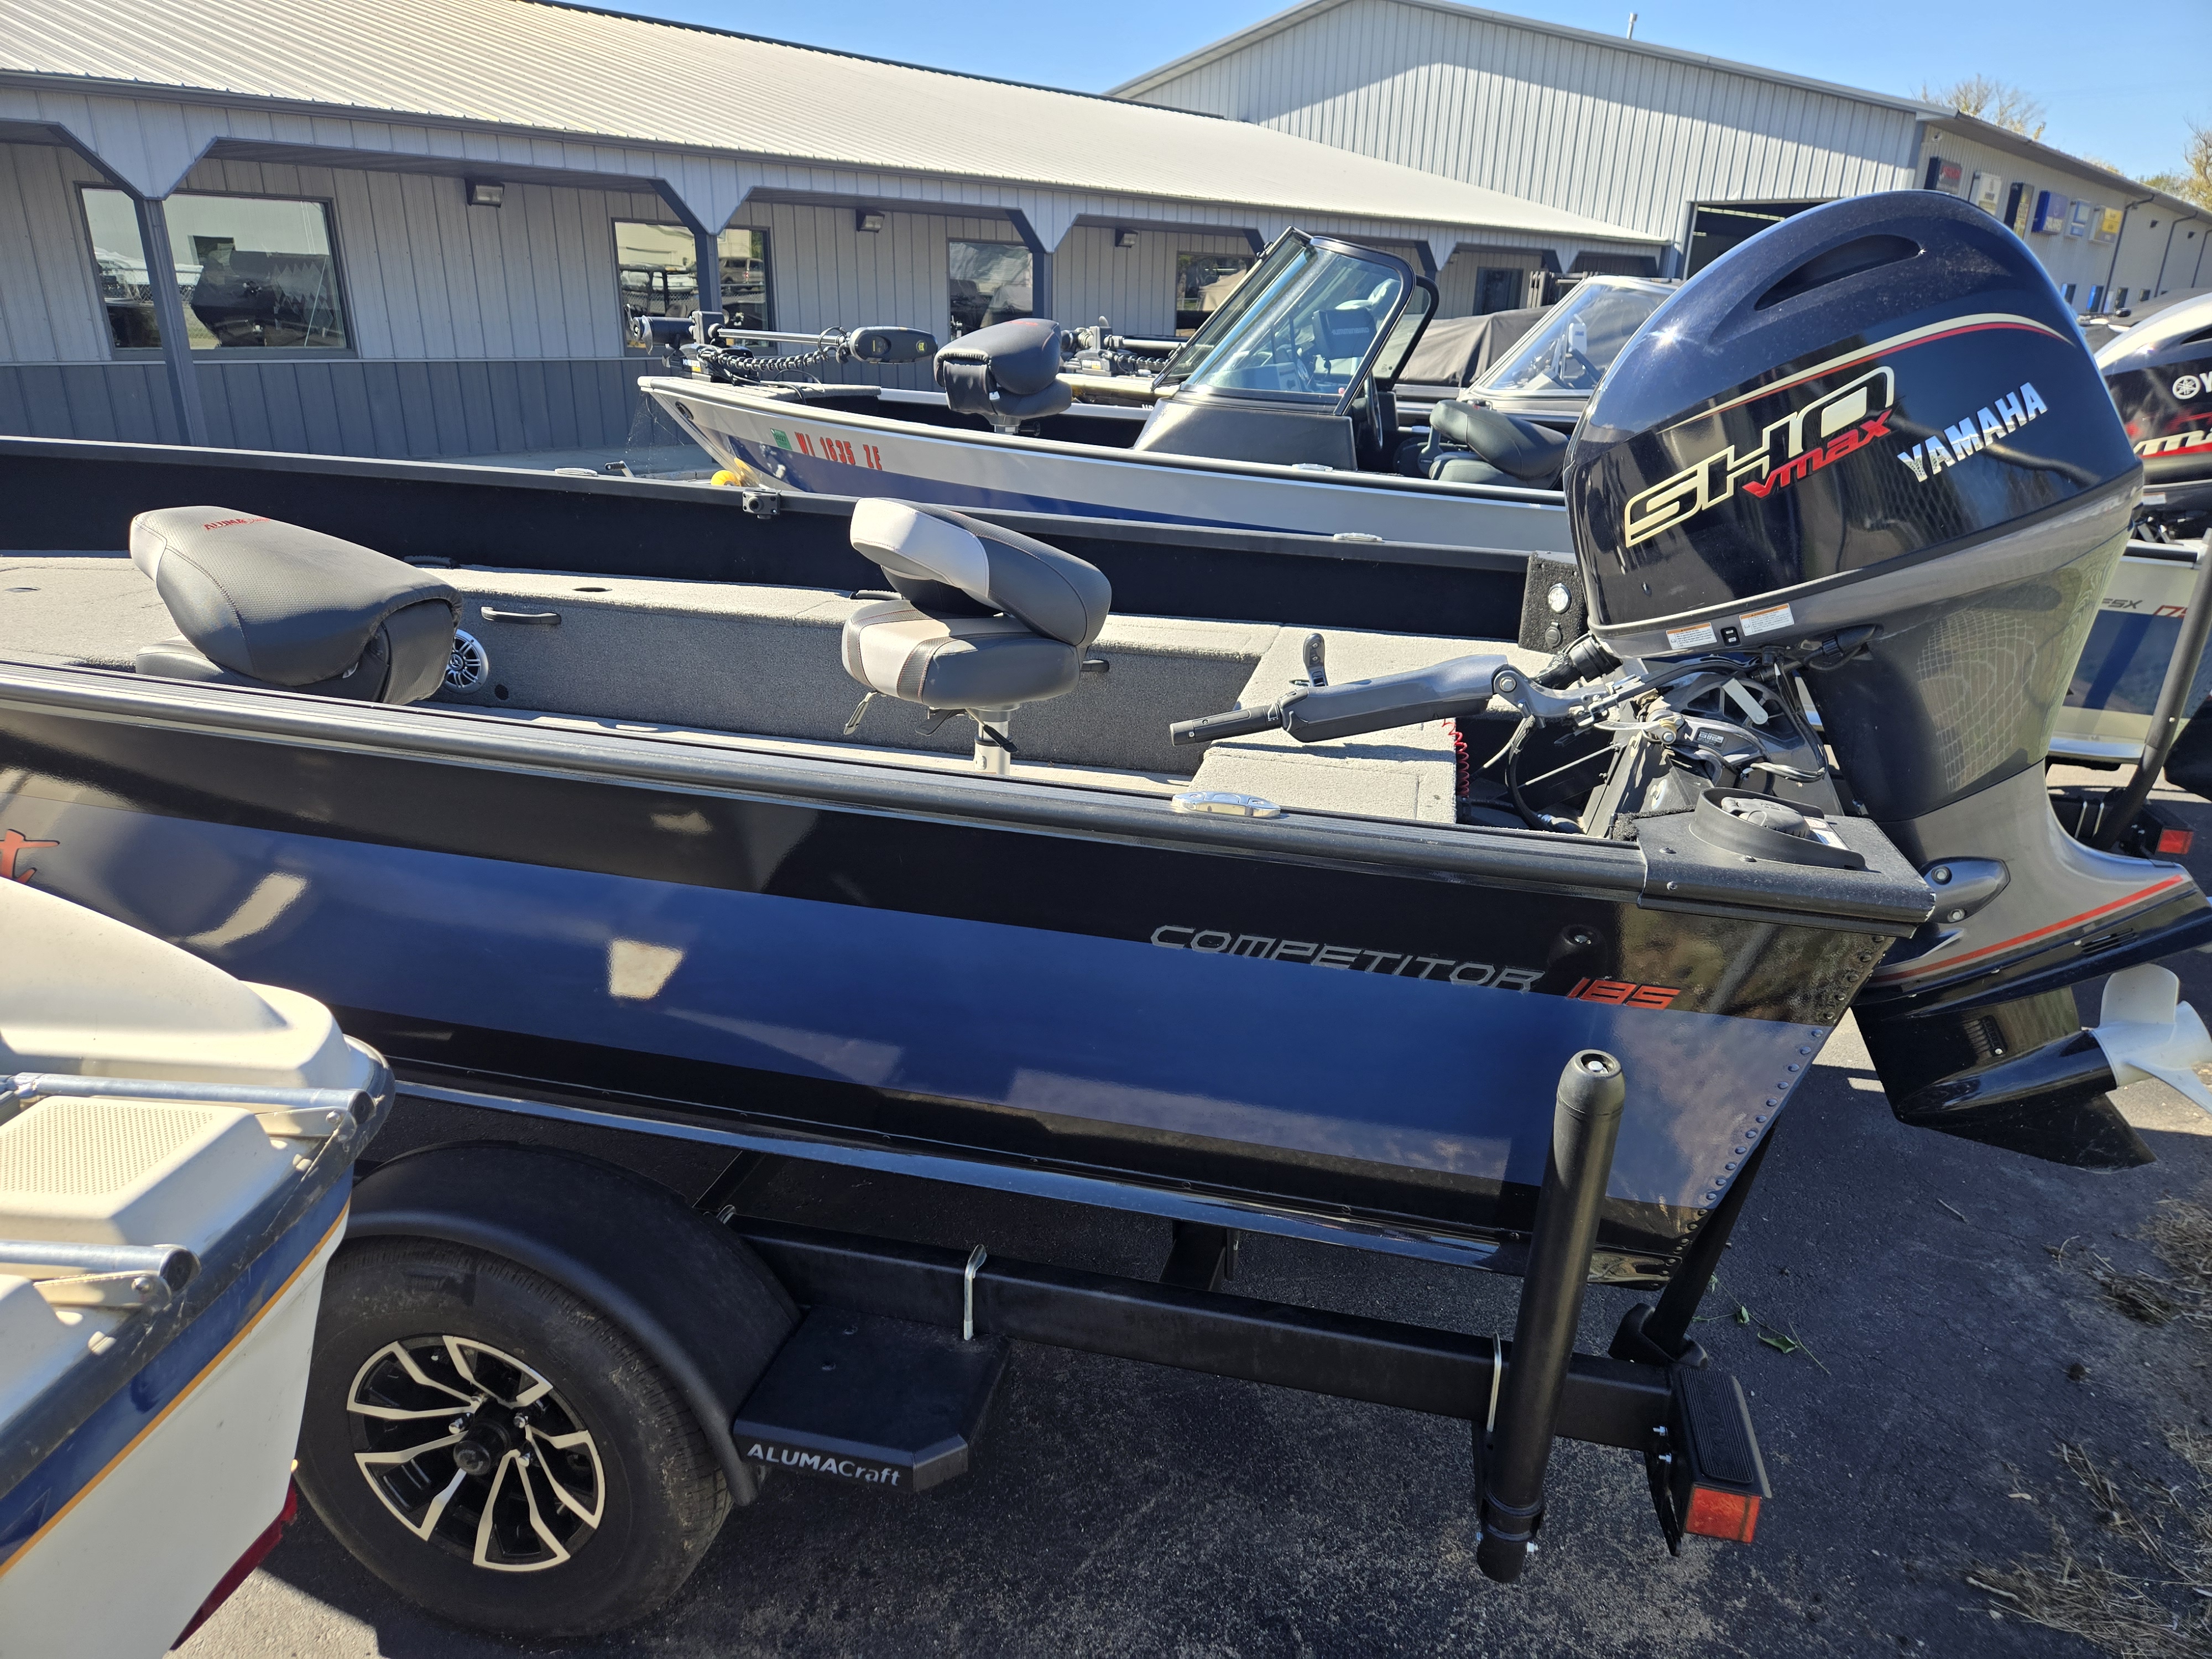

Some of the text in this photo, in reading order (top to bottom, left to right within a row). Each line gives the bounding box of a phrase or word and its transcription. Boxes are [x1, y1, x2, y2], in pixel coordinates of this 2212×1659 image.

[795, 431, 882, 470] WI 1635 ZE
[1625, 366, 1895, 547] SHO
[1897, 382, 2048, 482] YAMAHA
[1150, 925, 1681, 1010] COMPETITOR 185
[747, 1443, 901, 1486] ALUMACraft
